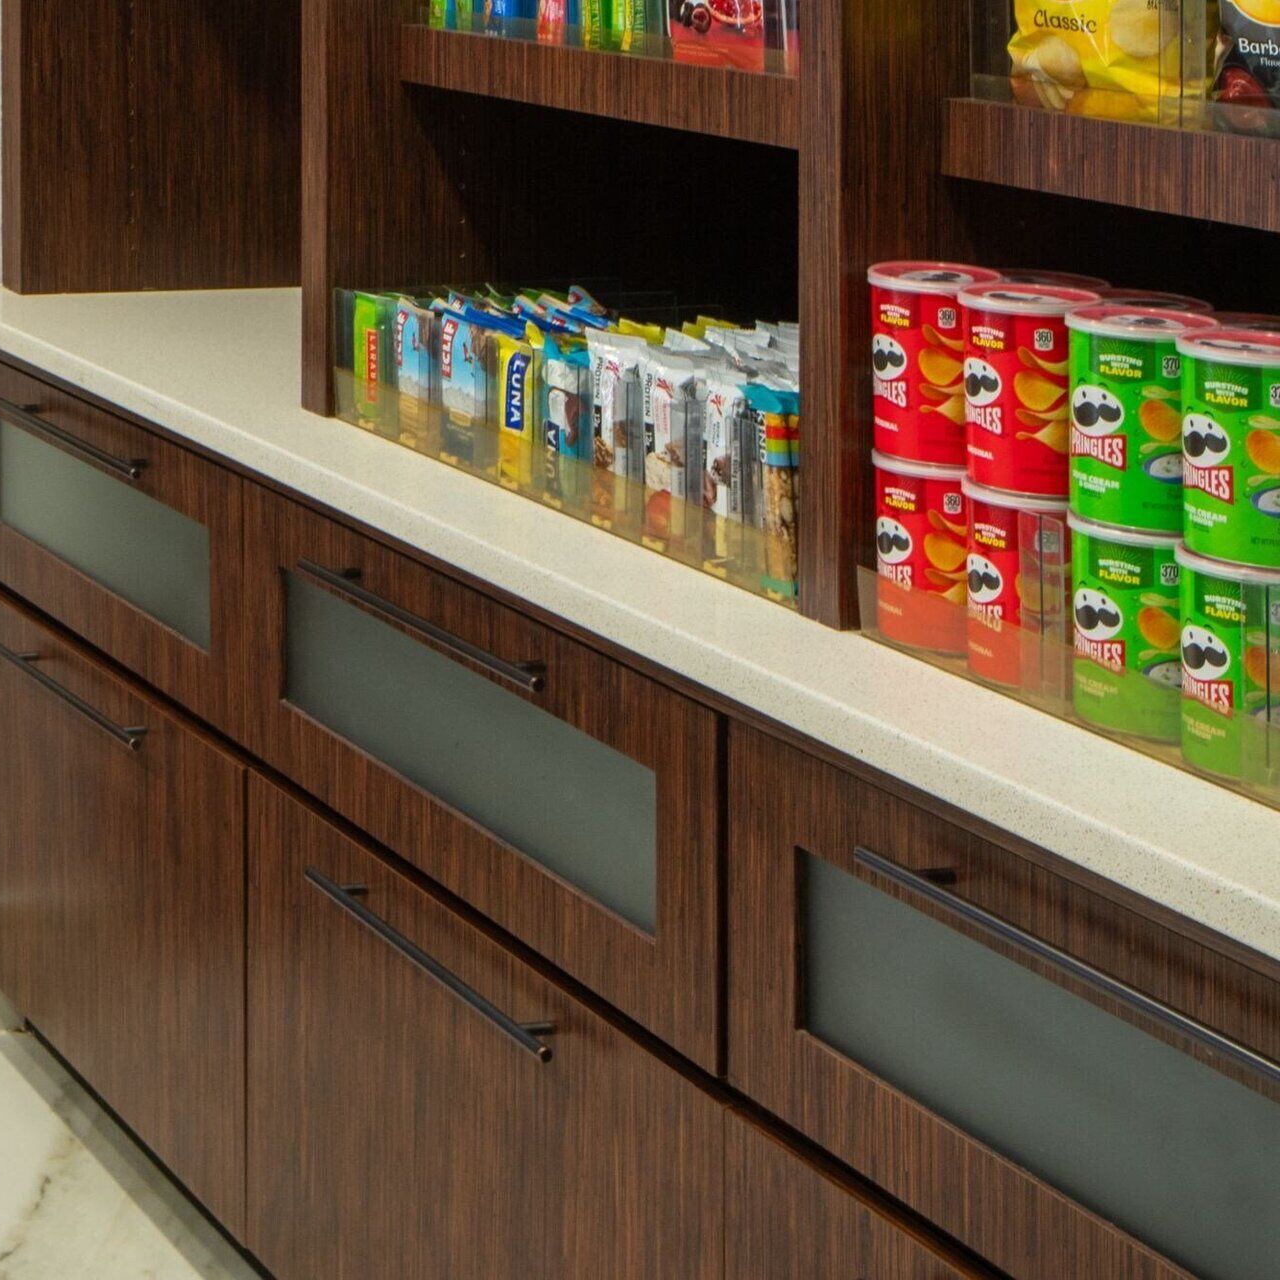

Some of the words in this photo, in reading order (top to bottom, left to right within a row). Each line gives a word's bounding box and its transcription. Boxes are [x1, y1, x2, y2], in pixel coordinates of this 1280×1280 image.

[1033, 9, 1098, 34] Classic
[880, 313, 910, 328] FLAVOR
[938, 308, 956, 320] 360
[971, 326, 1005, 338] BURSTING
[1035, 330, 1053, 343] 360
[972, 336, 1005, 350] FLAVOR
[1099, 353, 1144, 366] BURSTING
[1163, 356, 1180, 370] 370
[1099, 365, 1142, 379] FLAVOR
[509, 357, 526, 424] LUNA
[1204, 380, 1249, 395] BURSTING
[644, 373, 653, 418] PROTEIN
[1205, 392, 1249, 408] FLAVOR
[759, 410, 768, 464] KIND
[1072, 428, 1124, 468] PRINGLES
[885, 496, 916, 512] FLAVOR
[974, 532, 1007, 549] FLAVOR
[1098, 558, 1141, 573] BURSTING
[1161, 564, 1179, 578] 370
[1099, 569, 1141, 585] FLAVOR
[1203, 594, 1247, 611] BURSTING
[1205, 605, 1247, 623] FLAVOR
